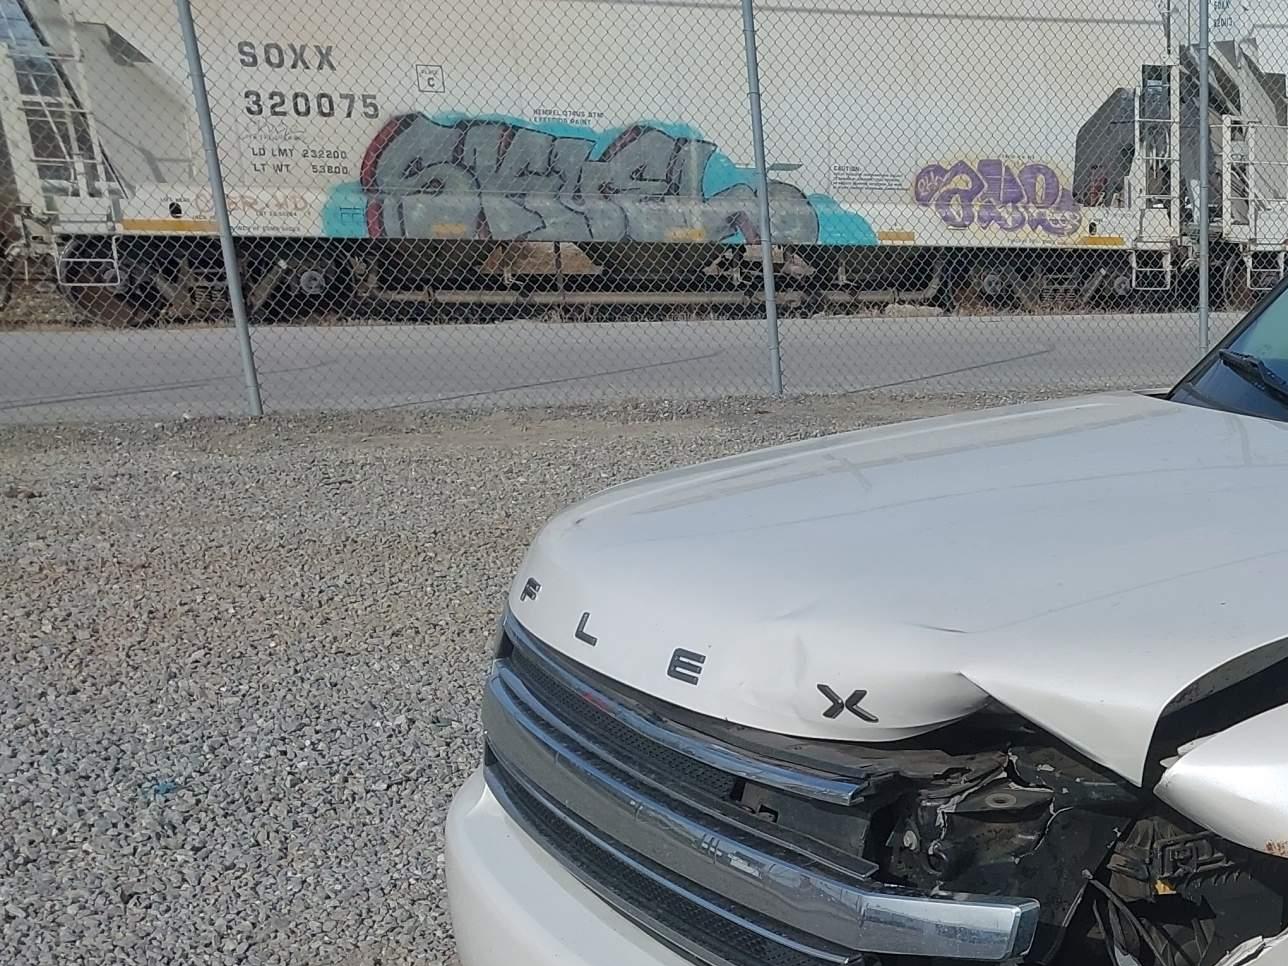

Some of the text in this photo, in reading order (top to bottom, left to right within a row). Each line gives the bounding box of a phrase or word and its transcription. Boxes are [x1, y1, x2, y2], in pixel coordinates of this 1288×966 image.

[237, 40, 337, 72] SOXX
[427, 77, 435, 88] C
[244, 90, 379, 120] 320075
[251, 147, 266, 156] LD
[302, 148, 348, 160] 232200
[253, 163, 348, 175] LT WT 53800
[519, 577, 880, 724] FLEX
